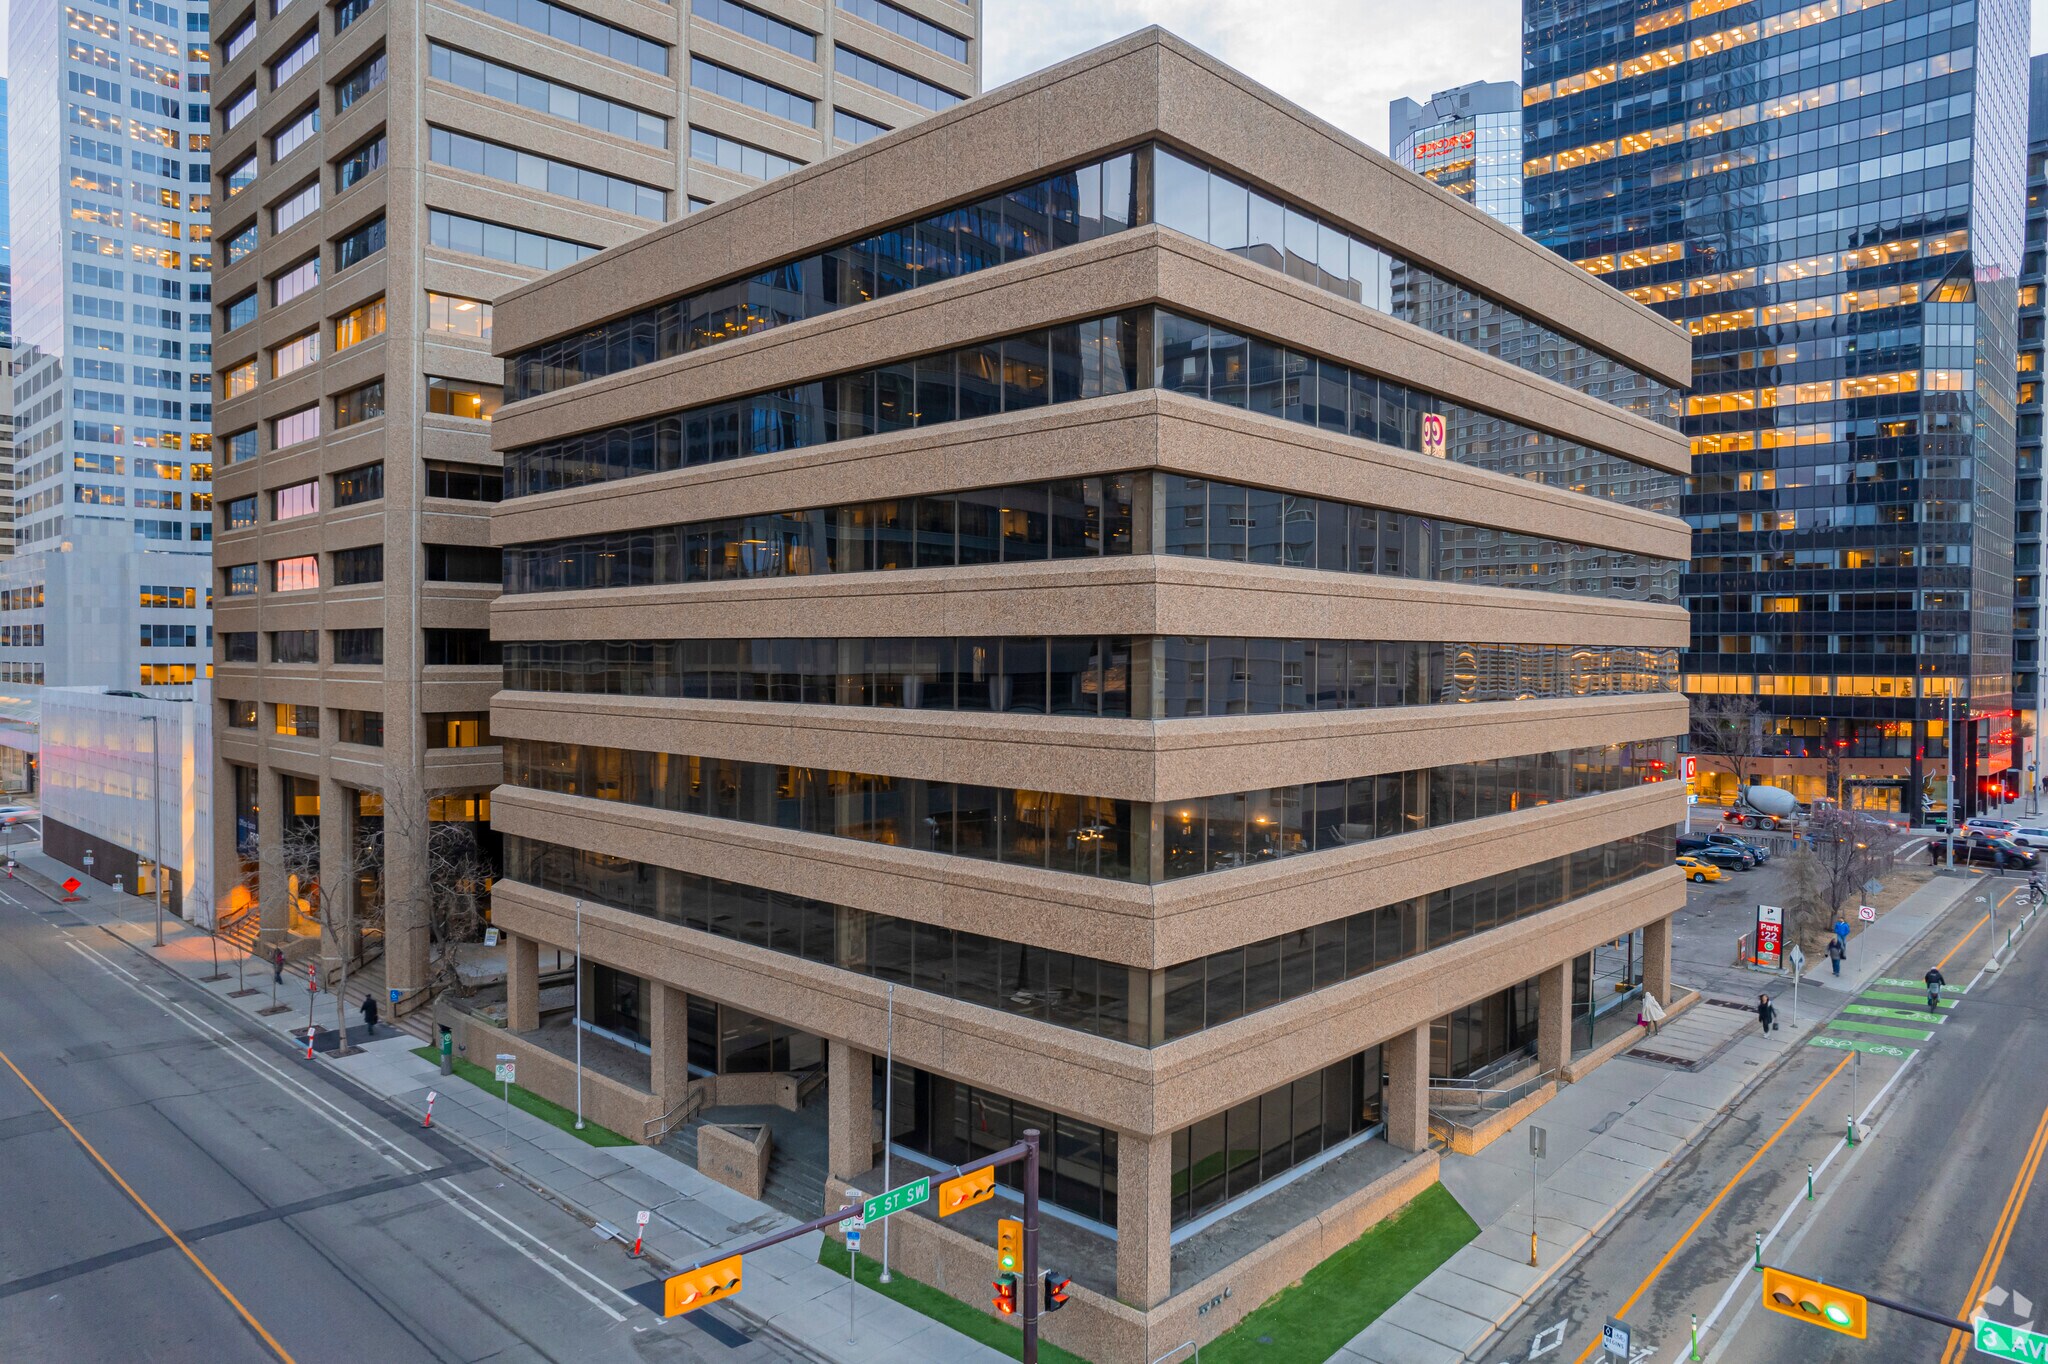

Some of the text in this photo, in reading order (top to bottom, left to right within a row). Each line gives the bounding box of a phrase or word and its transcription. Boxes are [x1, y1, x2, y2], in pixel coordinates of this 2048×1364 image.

[1760, 923, 1779, 932] Park
[1761, 931, 1777, 940] $22
[868, 1184, 925, 1218] 5 ST SW
[1605, 1337, 1624, 1349] BEGINS
[1982, 1327, 1998, 1347] 3
